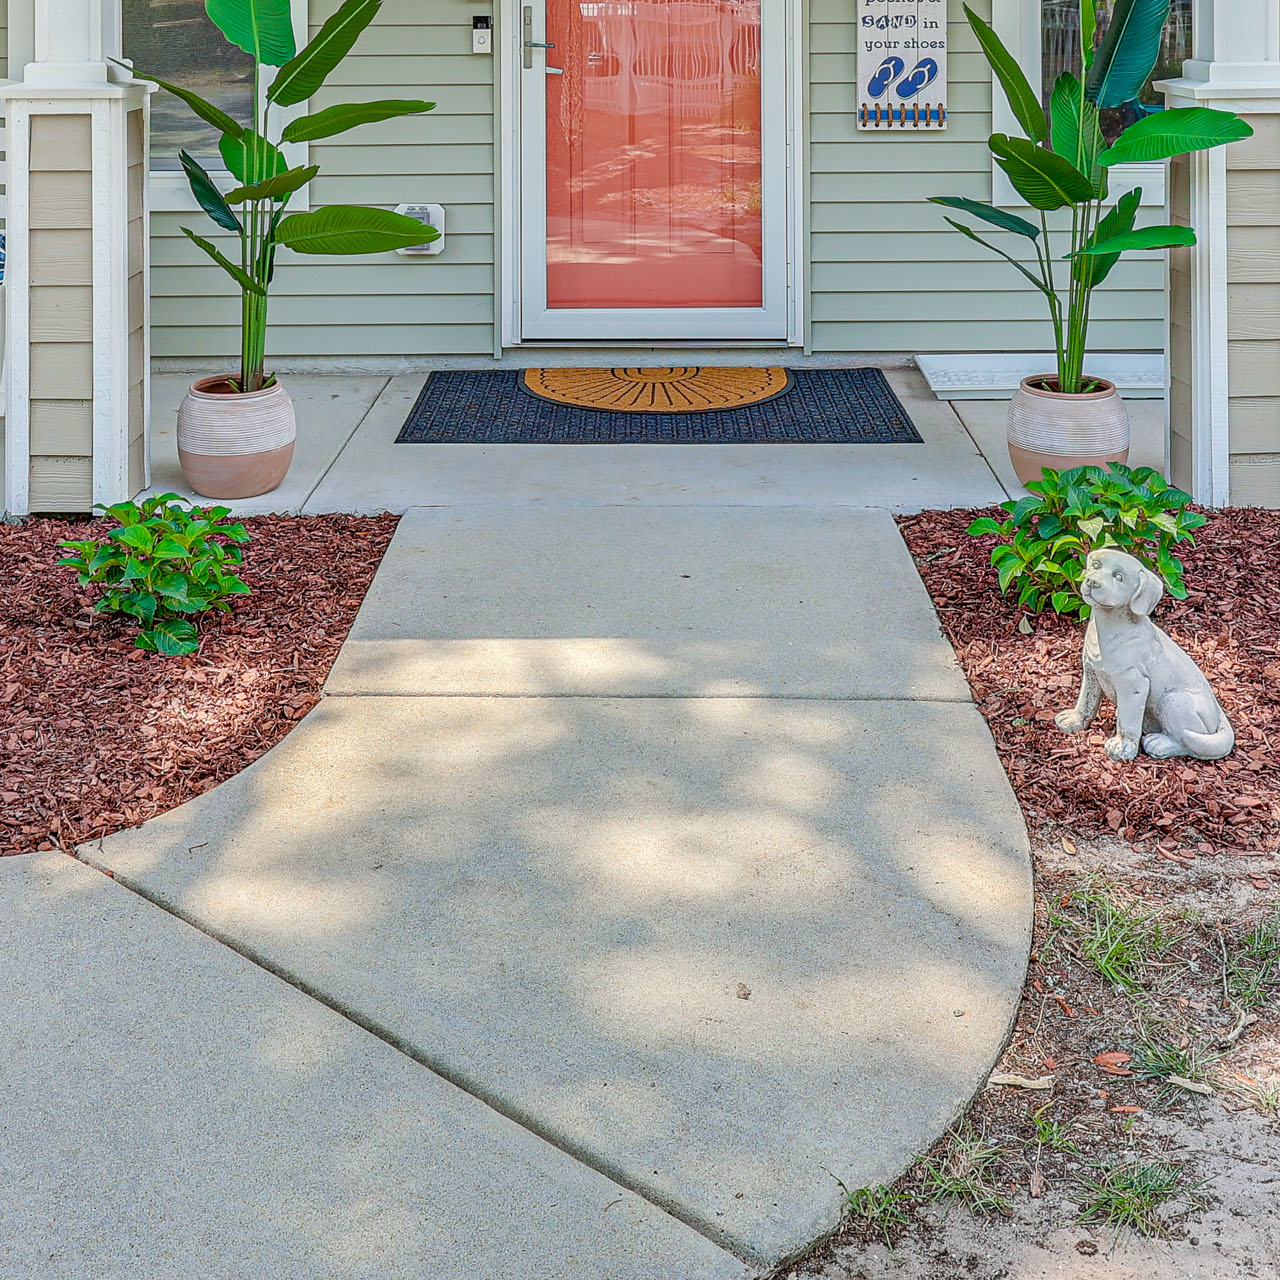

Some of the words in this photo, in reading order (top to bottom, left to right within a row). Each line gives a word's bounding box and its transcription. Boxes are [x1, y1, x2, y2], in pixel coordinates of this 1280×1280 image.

[861, 14, 917, 30] SAND
[923, 18, 939, 29] in
[865, 41, 900, 52] your
[903, 38, 945, 49] shoes
